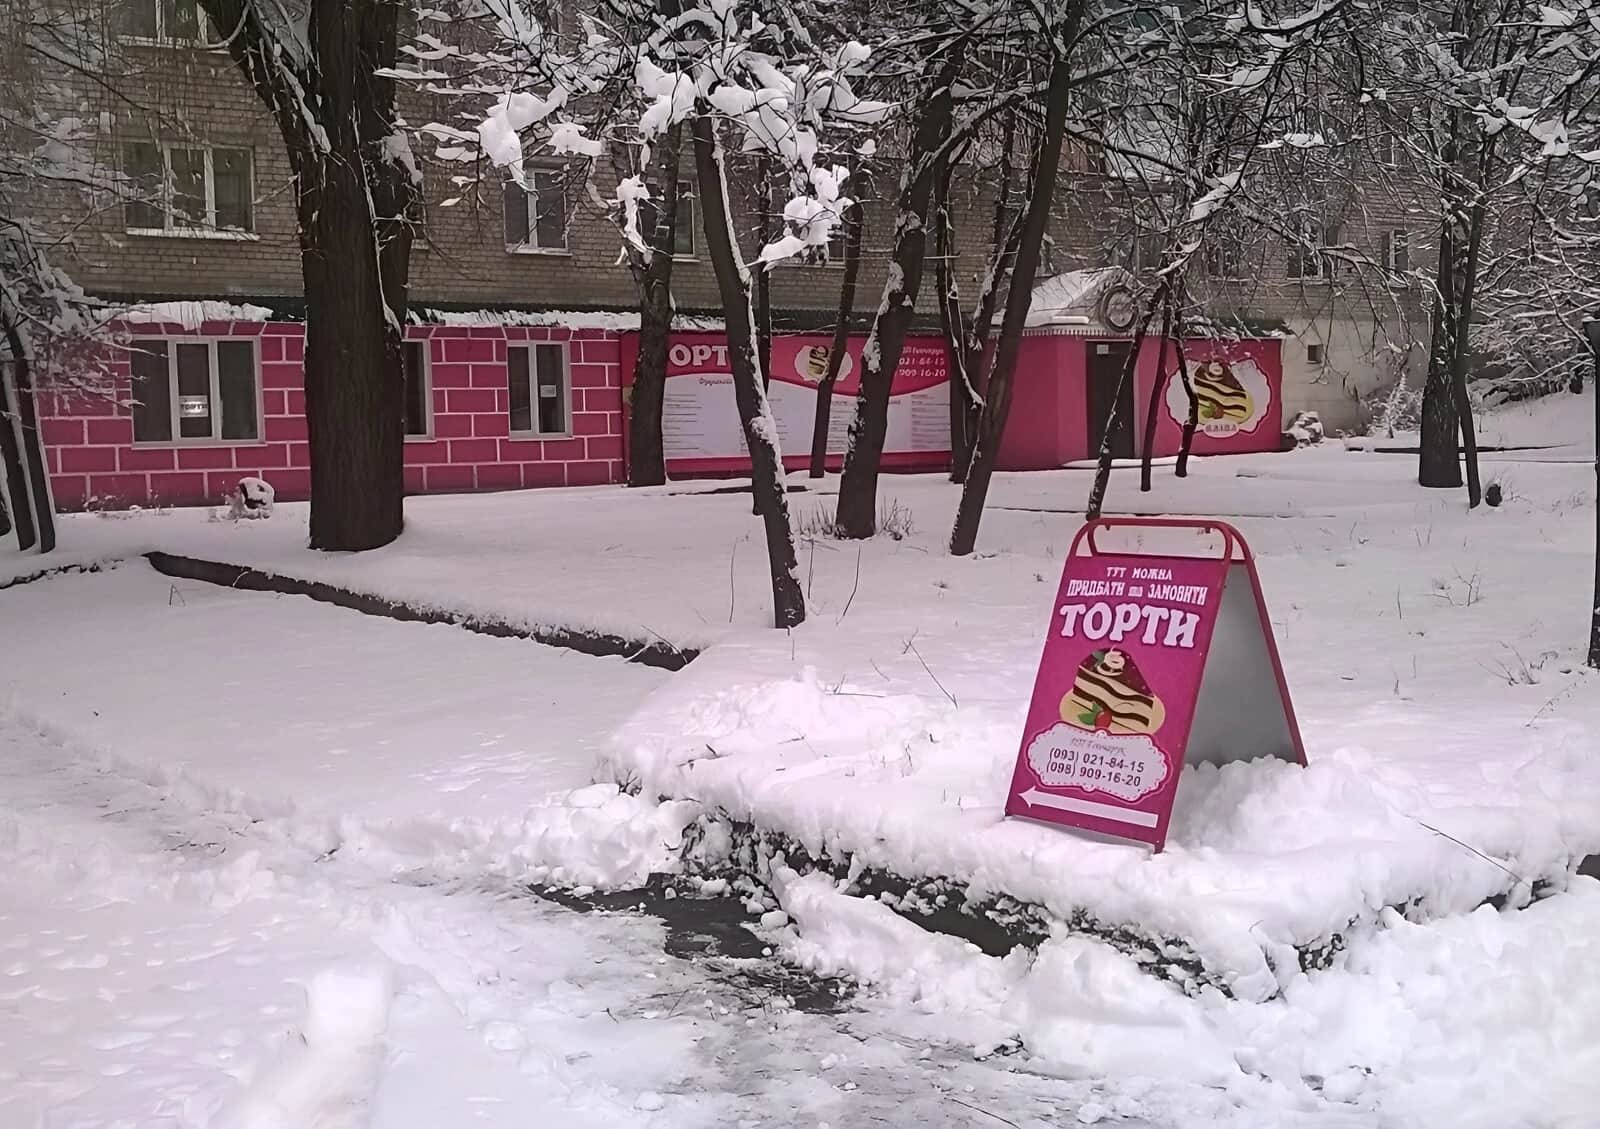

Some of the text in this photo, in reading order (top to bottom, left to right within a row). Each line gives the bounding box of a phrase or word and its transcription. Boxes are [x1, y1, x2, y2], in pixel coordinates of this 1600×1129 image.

[669, 344, 728, 366] ОРТ
[1106, 567, 1172, 581] ТУТ МОЖНА
[1066, 579, 1126, 597] ПРИДБАТИ
[1147, 583, 1208, 606] ЗАМОВИТИ
[1059, 602, 1200, 648] ТОРТИ
[1049, 747, 1079, 763] (093)
[1082, 752, 1145, 773] 021-84-15
[1046, 760, 1141, 787] (098) 909-16-20
